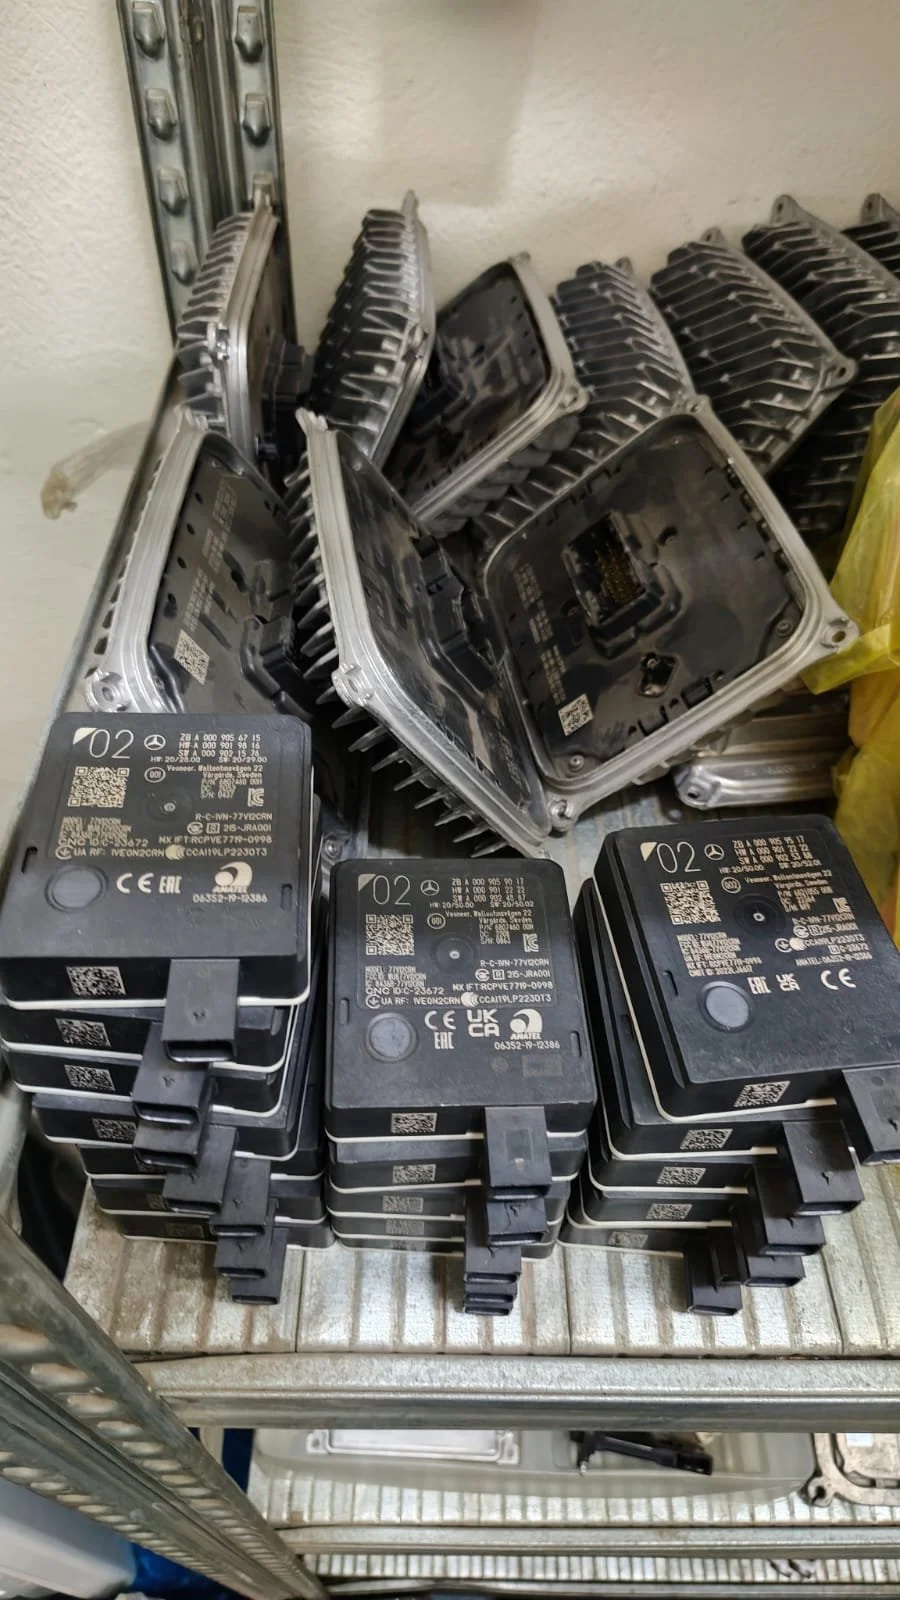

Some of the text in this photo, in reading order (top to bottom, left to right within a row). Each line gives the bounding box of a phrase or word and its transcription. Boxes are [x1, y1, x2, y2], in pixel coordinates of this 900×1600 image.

[89, 729, 134, 759] 02
[194, 733, 200, 742] A
[202, 733, 218, 742] 000
[220, 733, 235, 742] 905
[238, 733, 249, 742] 67
[252, 733, 261, 742] 15
[202, 742, 217, 750] 000
[219, 742, 233, 750] 901
[201, 750, 216, 758] 000
[656, 841, 702, 873] 02
[116, 872, 155, 894] CE
[472, 878, 486, 886] 000
[372, 875, 411, 905] 02
[473, 886, 486, 894] 000
[820, 967, 858, 990] CE
[424, 1009, 457, 1030] CE
[466, 1008, 499, 1023] UK
[468, 1022, 501, 1037] CA
